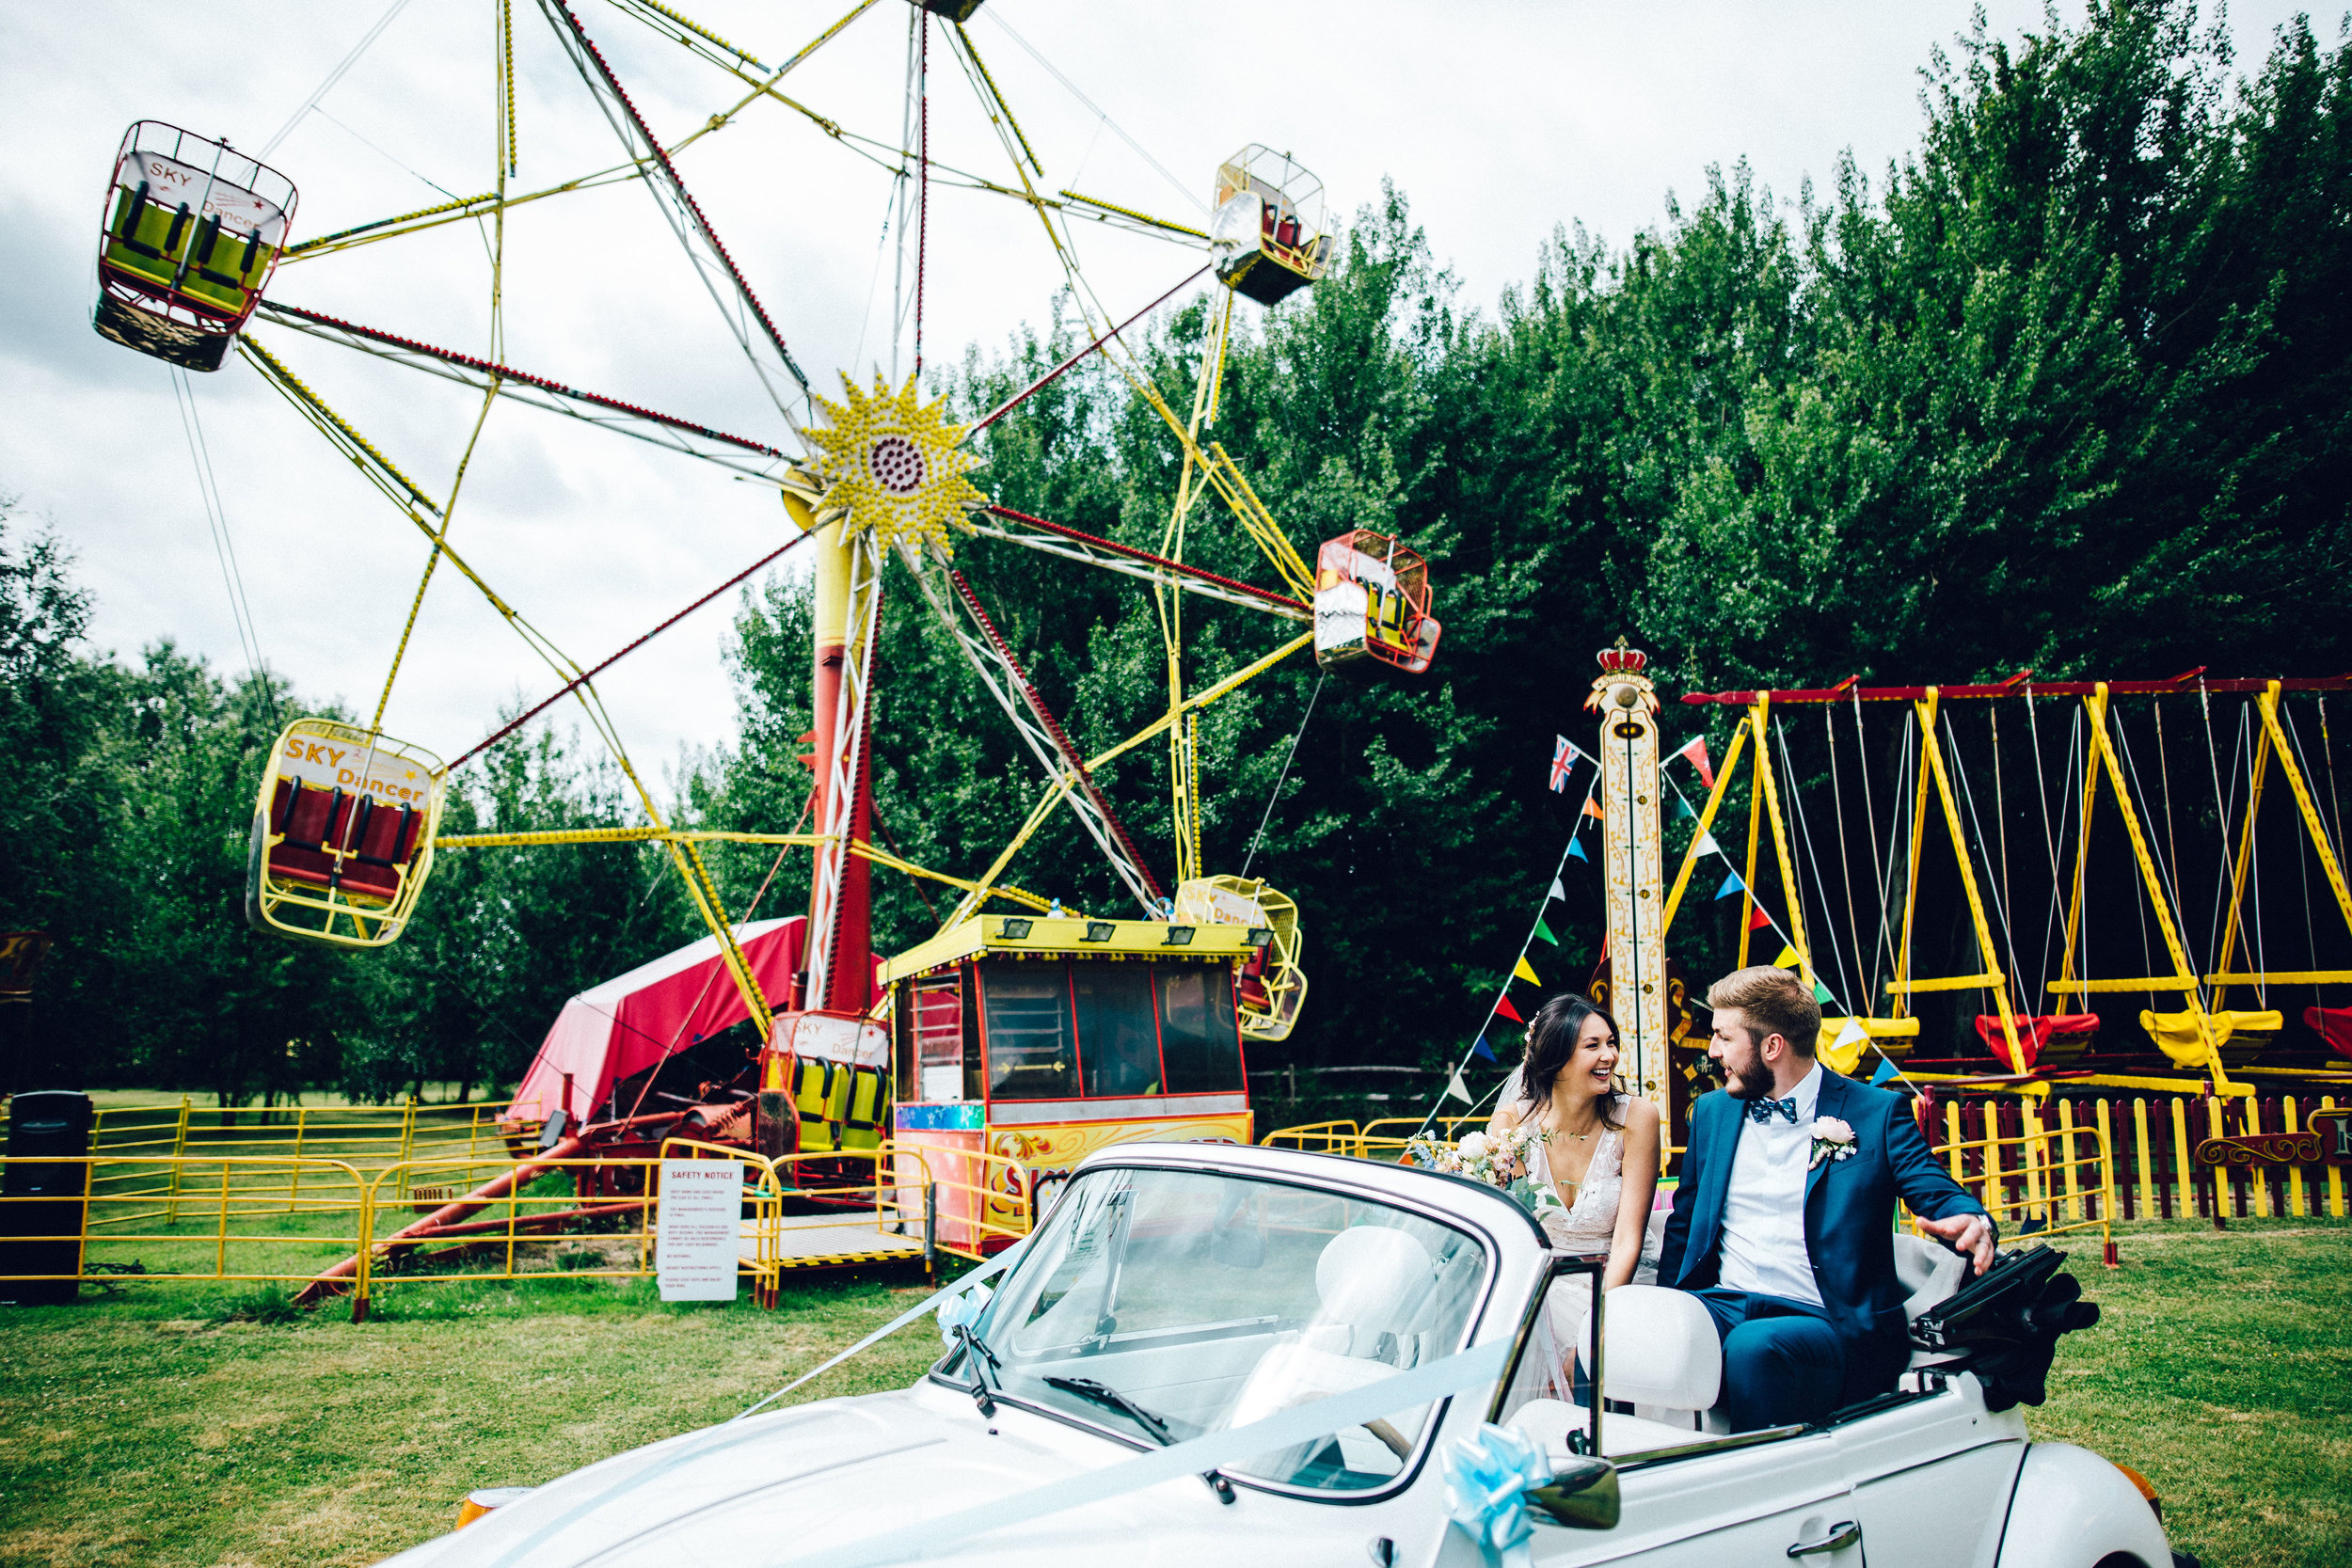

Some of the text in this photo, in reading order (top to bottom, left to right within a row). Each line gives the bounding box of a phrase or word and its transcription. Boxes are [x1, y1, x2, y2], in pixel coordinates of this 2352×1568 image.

[150, 162, 192, 187] SKY
[202, 200, 262, 230] Dancer
[285, 739, 345, 768] SKY
[337, 768, 424, 802] Dancer
[797, 1022, 822, 1035] SKY
[671, 1170, 734, 1180] SAFETY NOTICE
